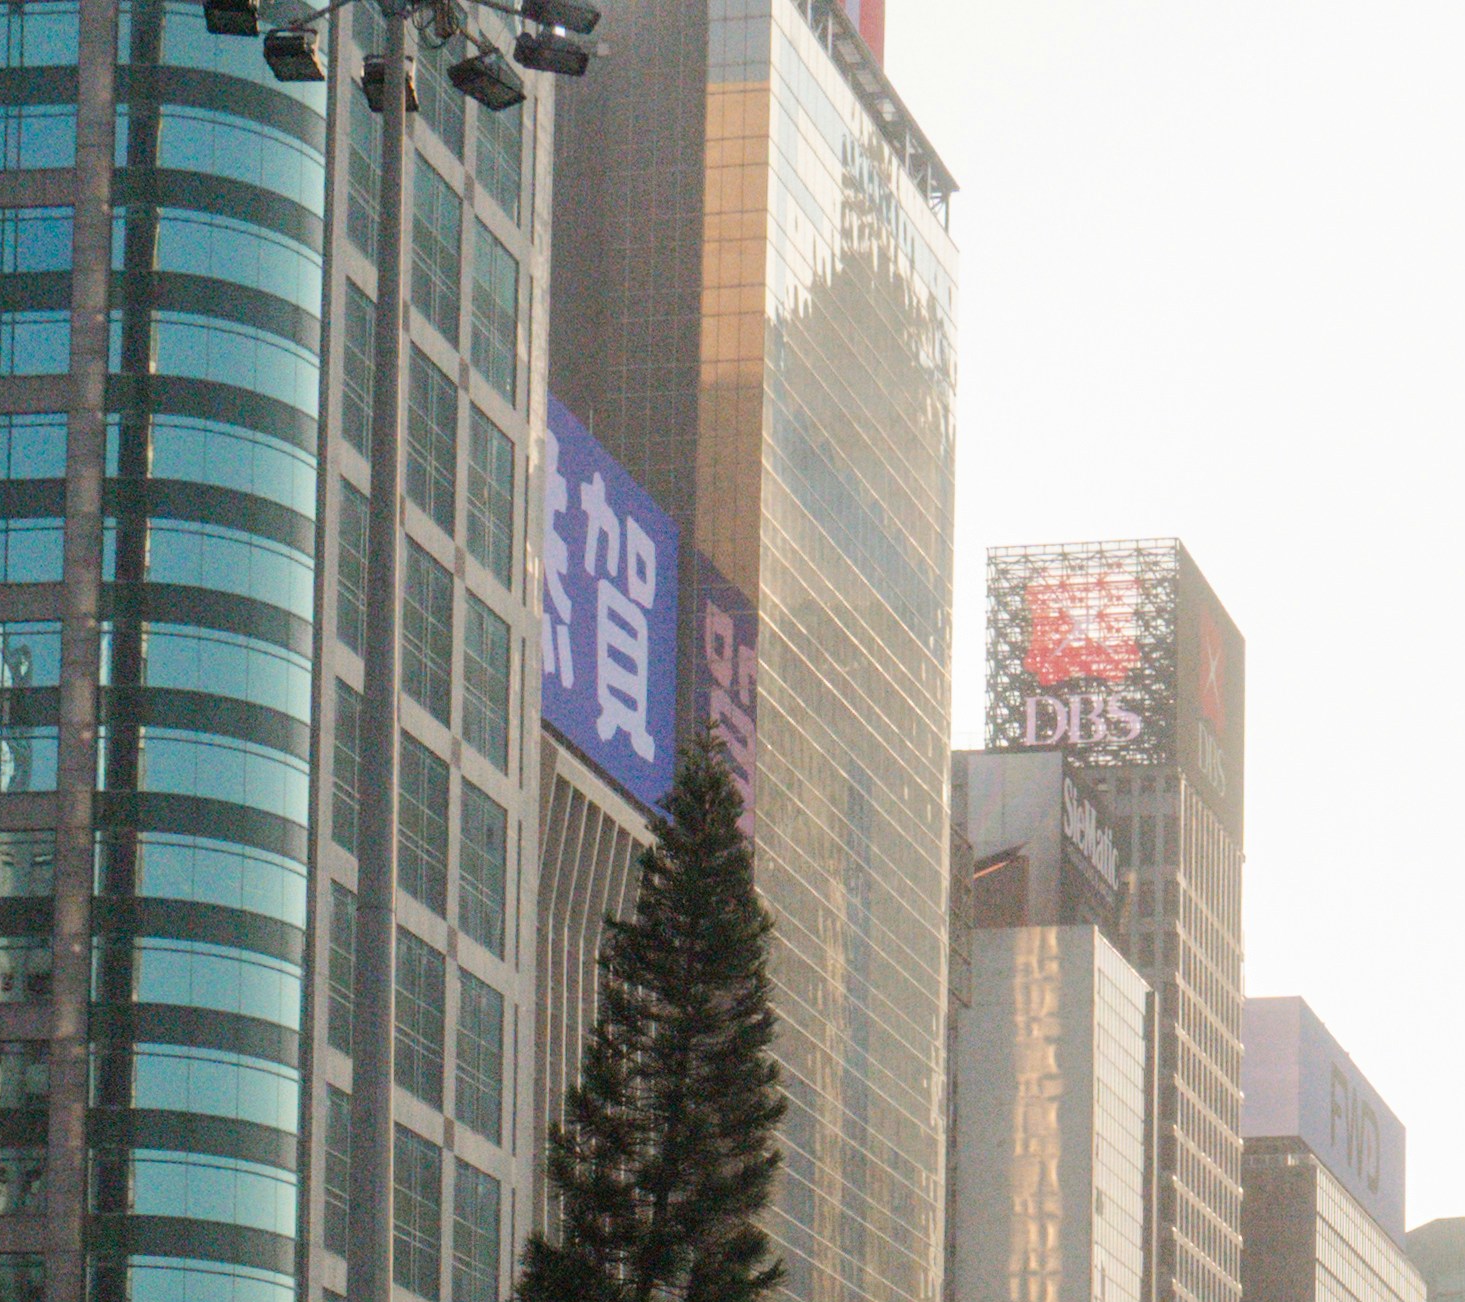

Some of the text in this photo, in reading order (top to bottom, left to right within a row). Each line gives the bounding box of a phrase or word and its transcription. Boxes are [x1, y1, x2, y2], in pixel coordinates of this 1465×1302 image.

[1022, 693, 1142, 747] DBS
[1198, 721, 1226, 798] DBS
[1063, 777, 1120, 891] SieMatic
[1329, 1060, 1381, 1196] FWD
